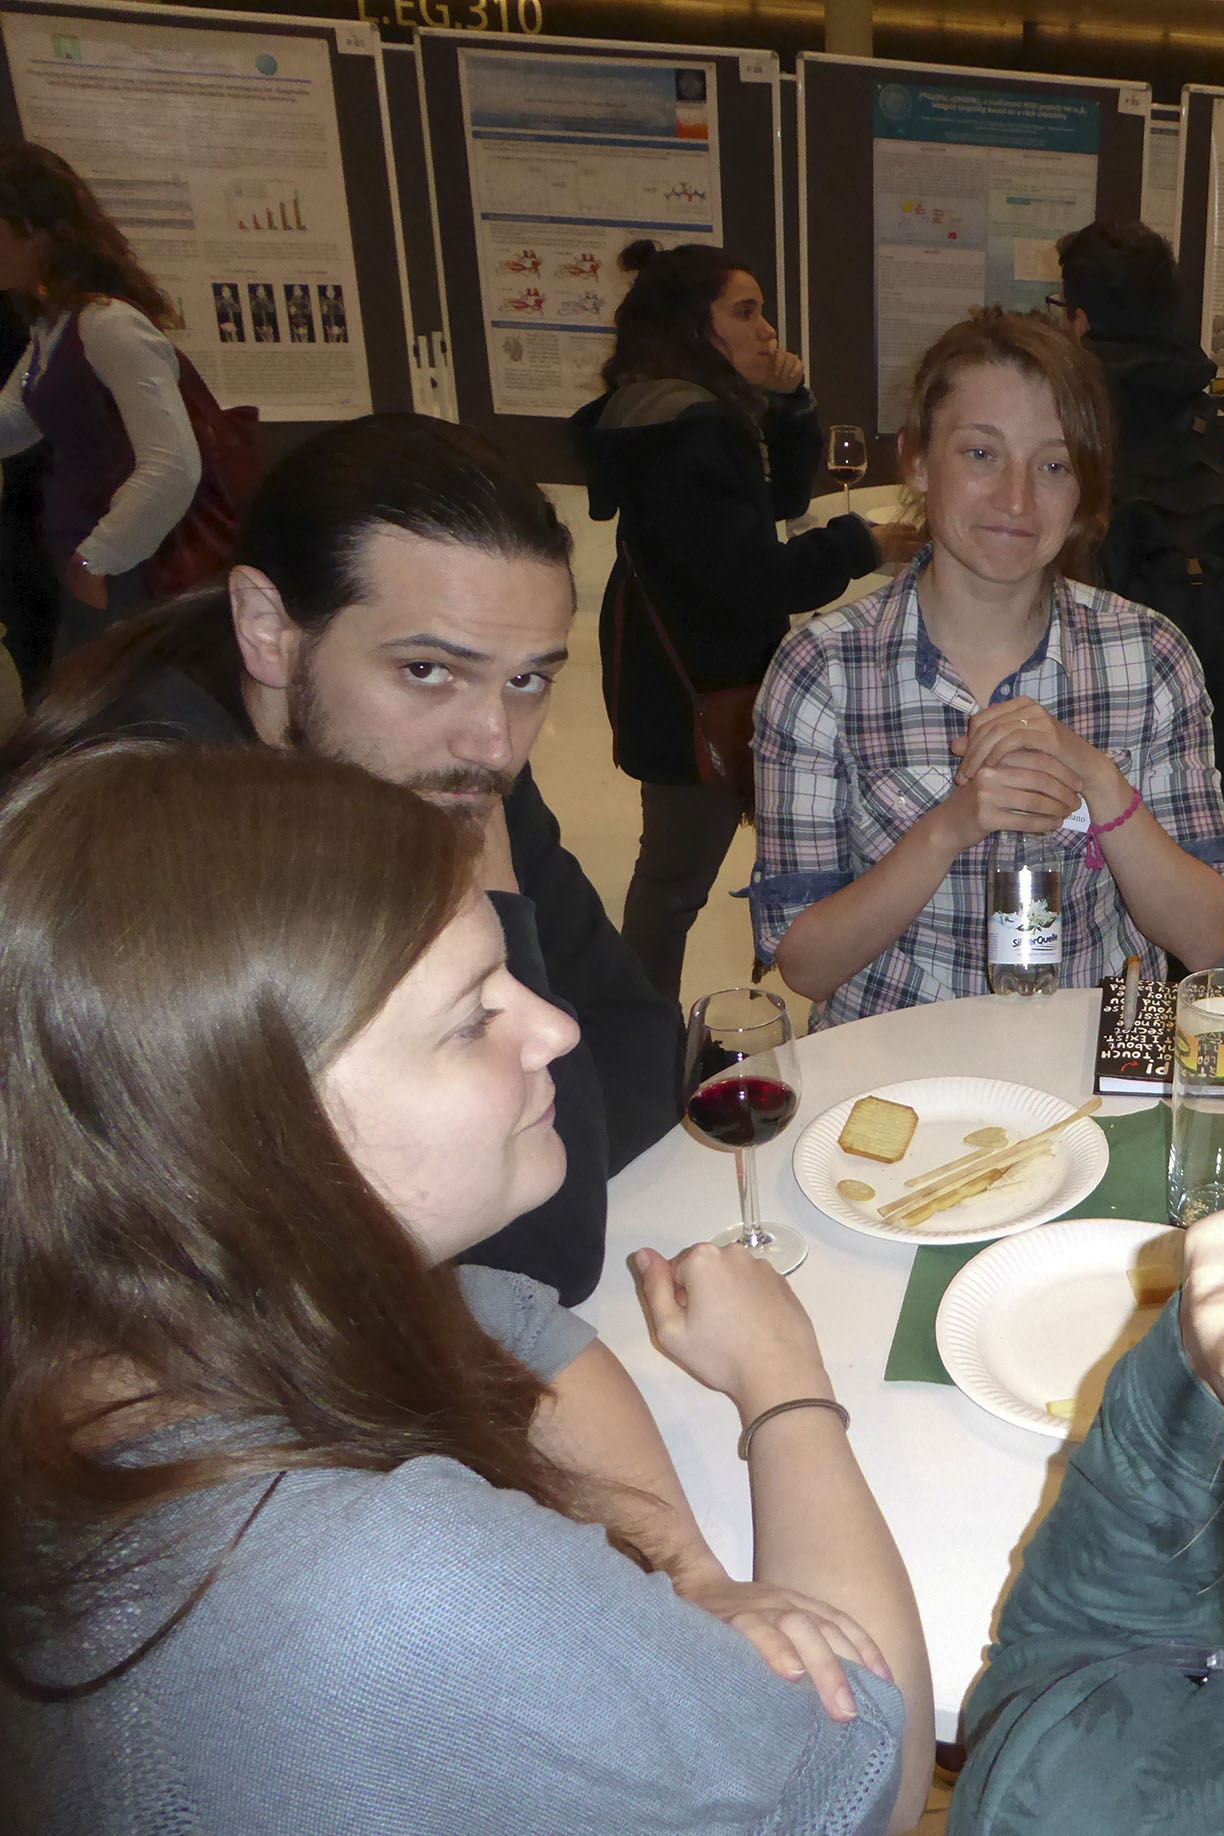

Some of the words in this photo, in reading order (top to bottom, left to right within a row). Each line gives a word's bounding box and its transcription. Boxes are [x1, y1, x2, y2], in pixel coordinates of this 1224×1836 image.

[358, 0, 544, 35] L.EG.310
[1142, 998, 1171, 1007] and
[1141, 1006, 1174, 1014] your
[1114, 1027, 1165, 1036] secret
[1108, 1042, 1153, 1052] about
[1101, 1050, 1151, 1060] TOUCH
